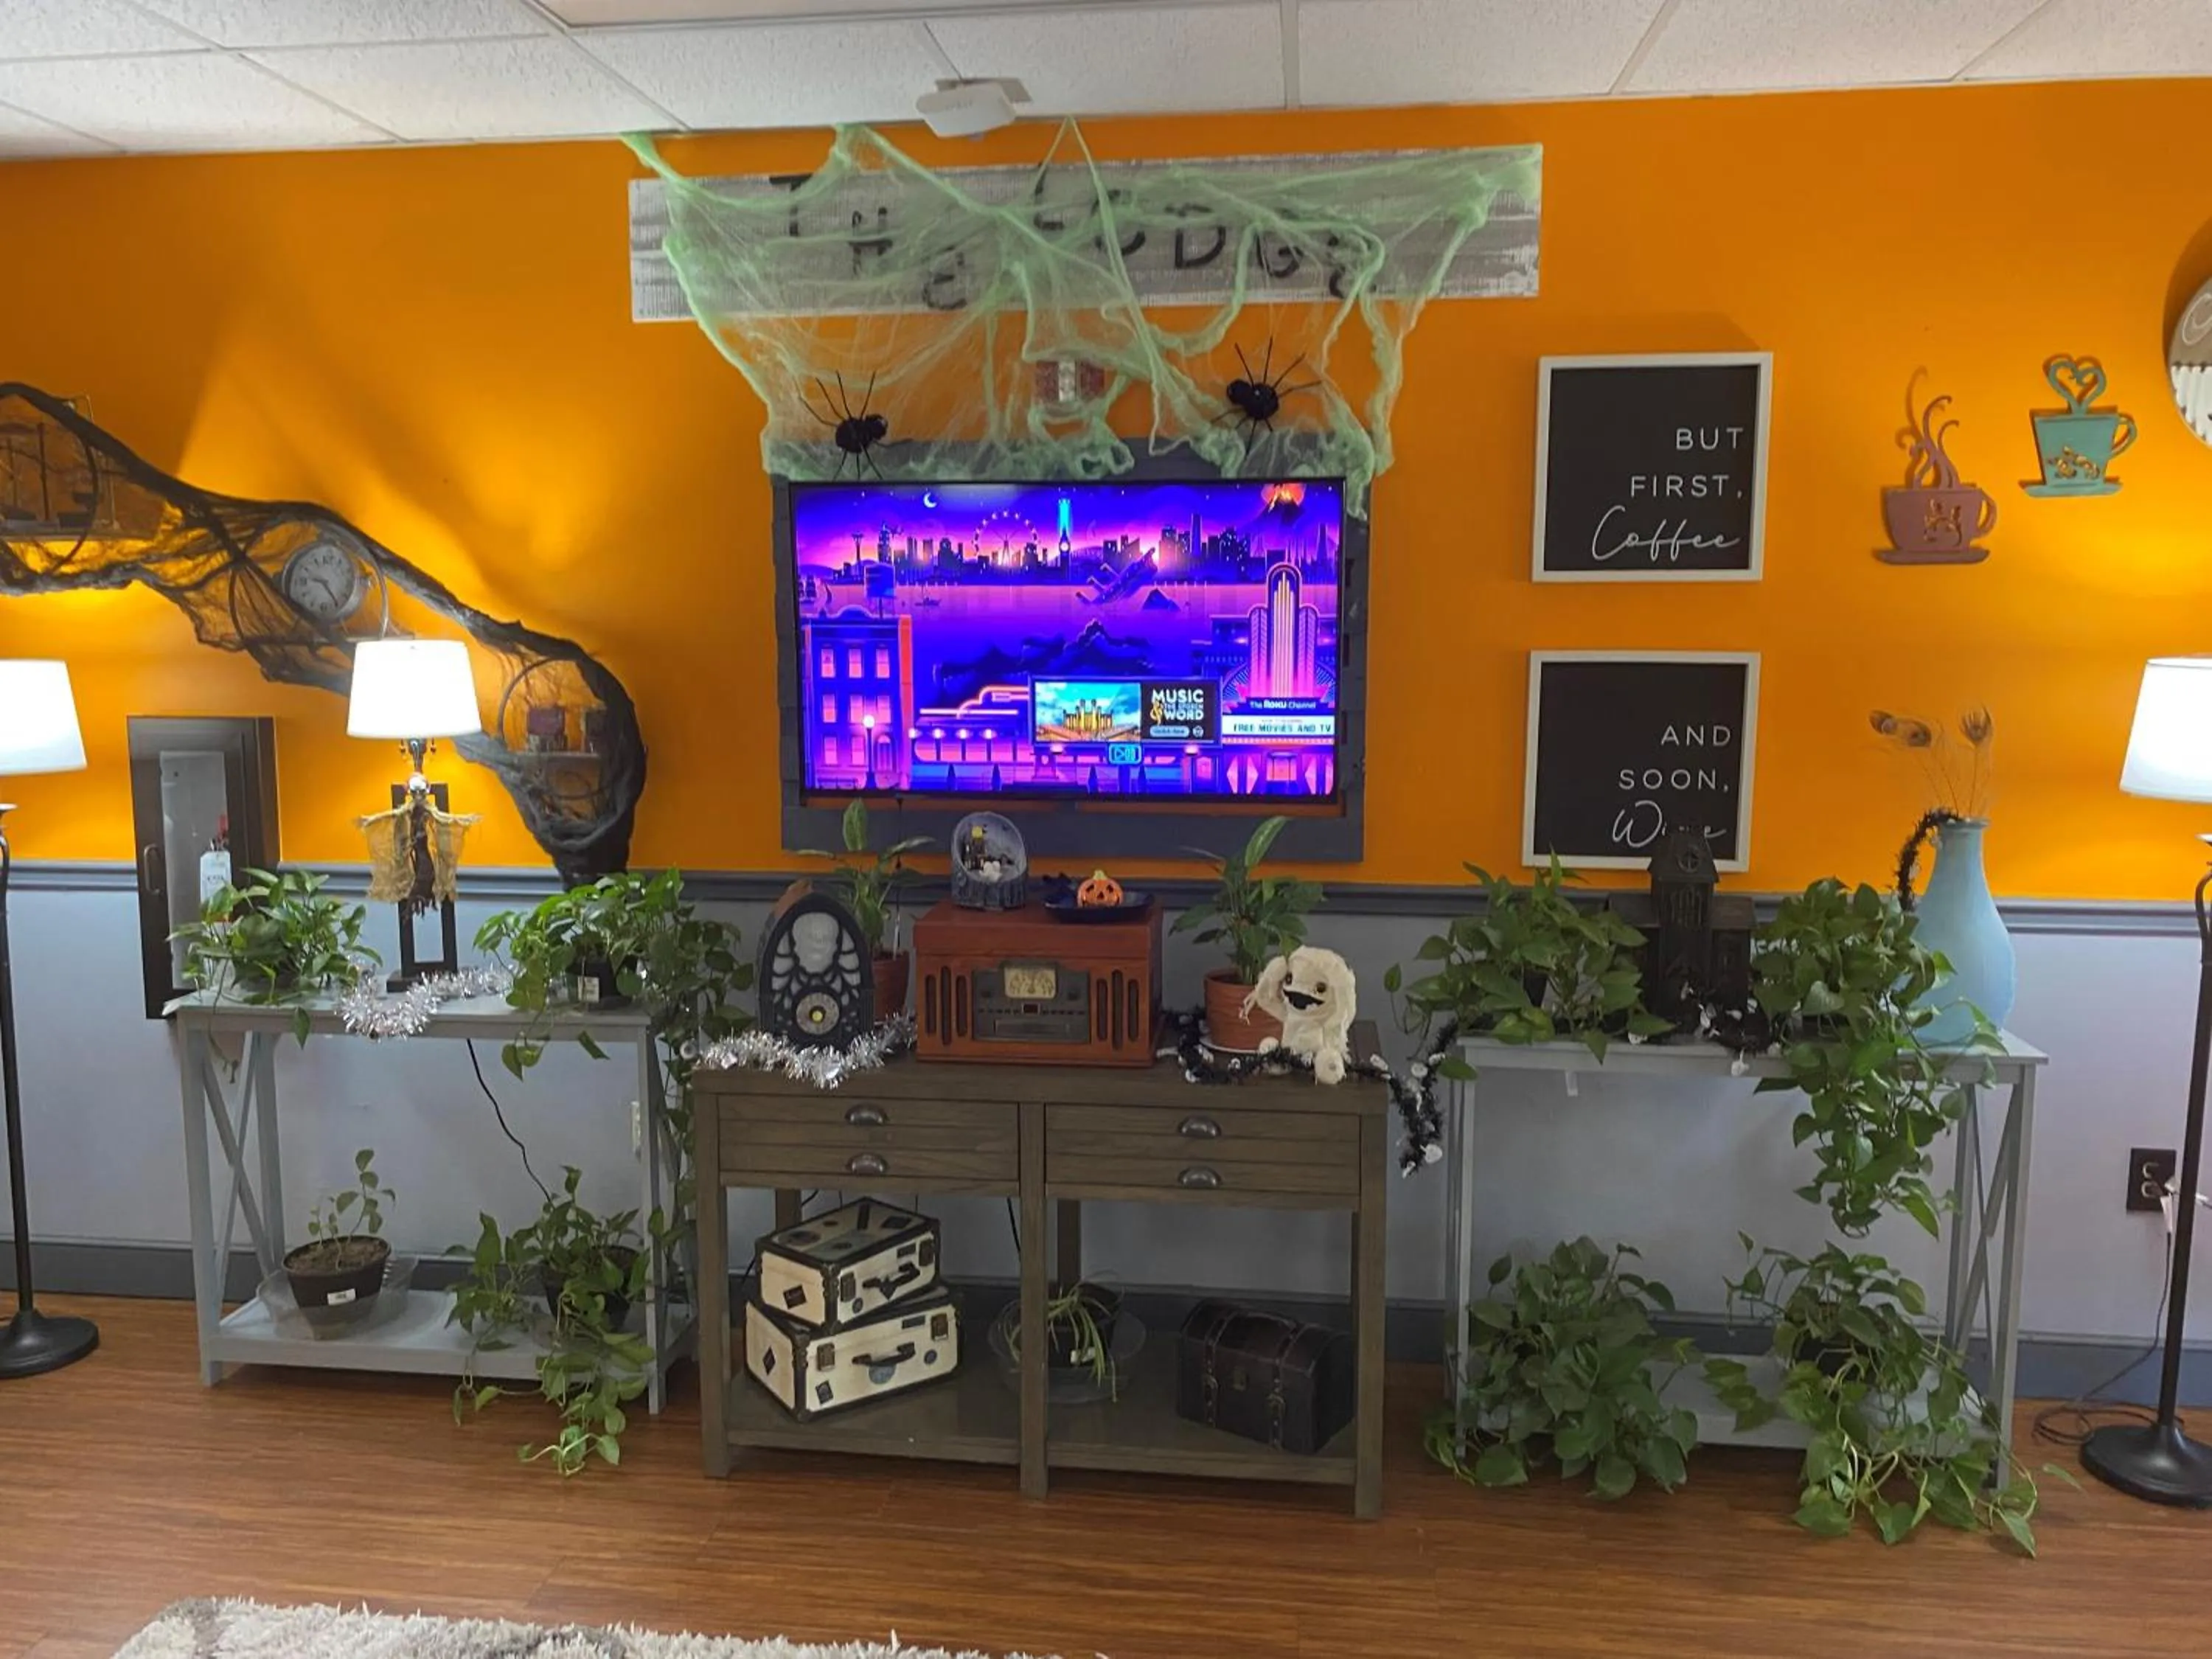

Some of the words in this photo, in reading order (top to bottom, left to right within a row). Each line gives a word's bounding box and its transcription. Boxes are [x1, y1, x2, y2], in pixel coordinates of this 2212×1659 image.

[1677, 427, 1743, 450] BUT
[1630, 476, 1742, 498] FIRST,
[1592, 505, 1739, 561] Coffee
[1152, 689, 1203, 703] MUSIC
[1298, 723, 1315, 732] AND
[1320, 723, 1332, 732] TV
[1661, 726, 1731, 746] AND
[1618, 770, 1728, 793] SOON,
[1613, 801, 1726, 847] Wie
